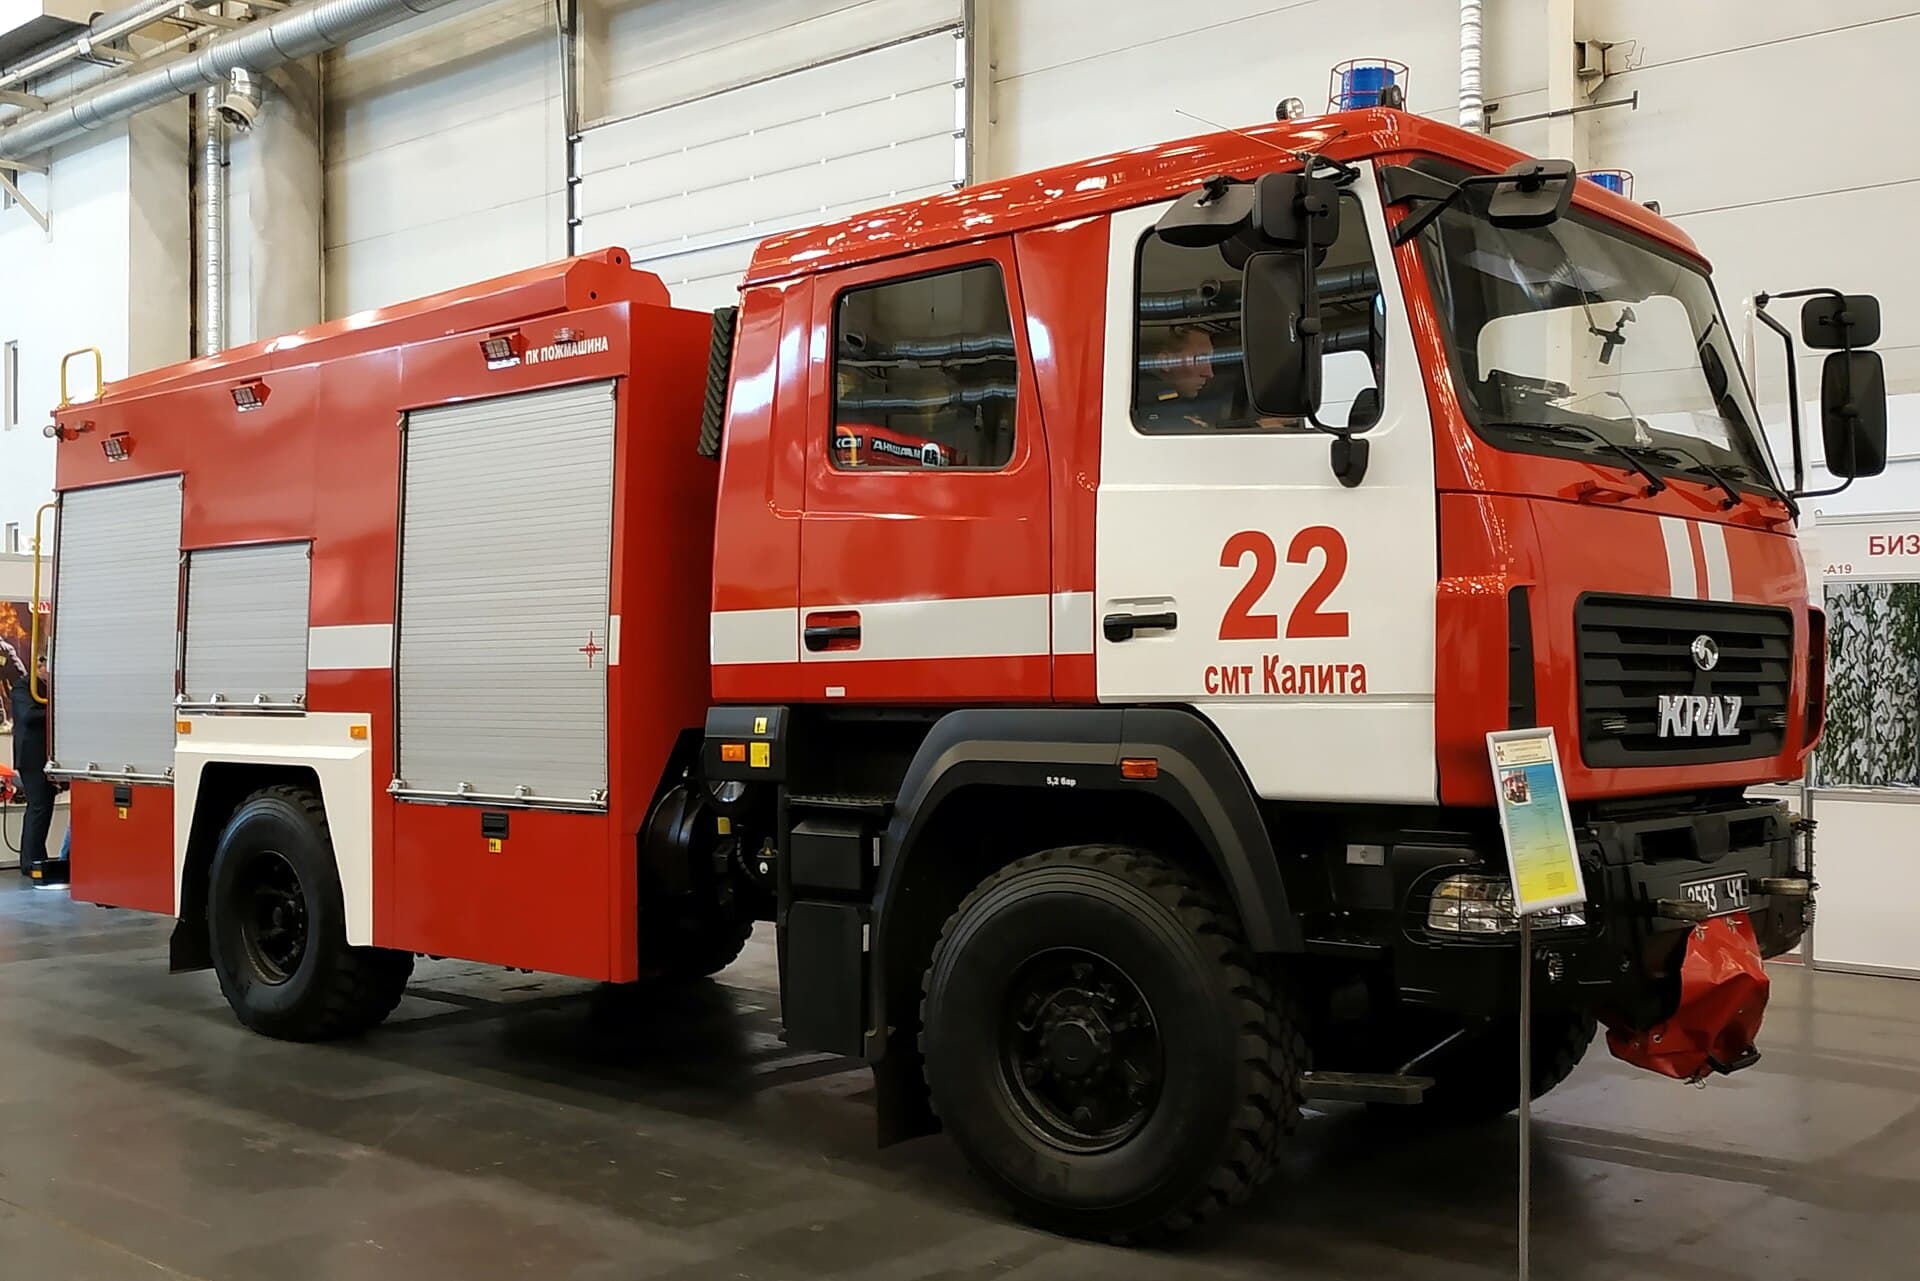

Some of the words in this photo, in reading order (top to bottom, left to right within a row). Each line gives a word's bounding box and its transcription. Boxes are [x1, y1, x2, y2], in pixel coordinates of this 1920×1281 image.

[525, 348, 539, 365] ПК
[540, 336, 608, 362] ПОЖМАШИНА
[1218, 525, 1350, 641] 22
[1204, 665, 1253, 694] смт
[1262, 654, 1368, 694] Калита
[1657, 695, 1742, 737] KRAZ
